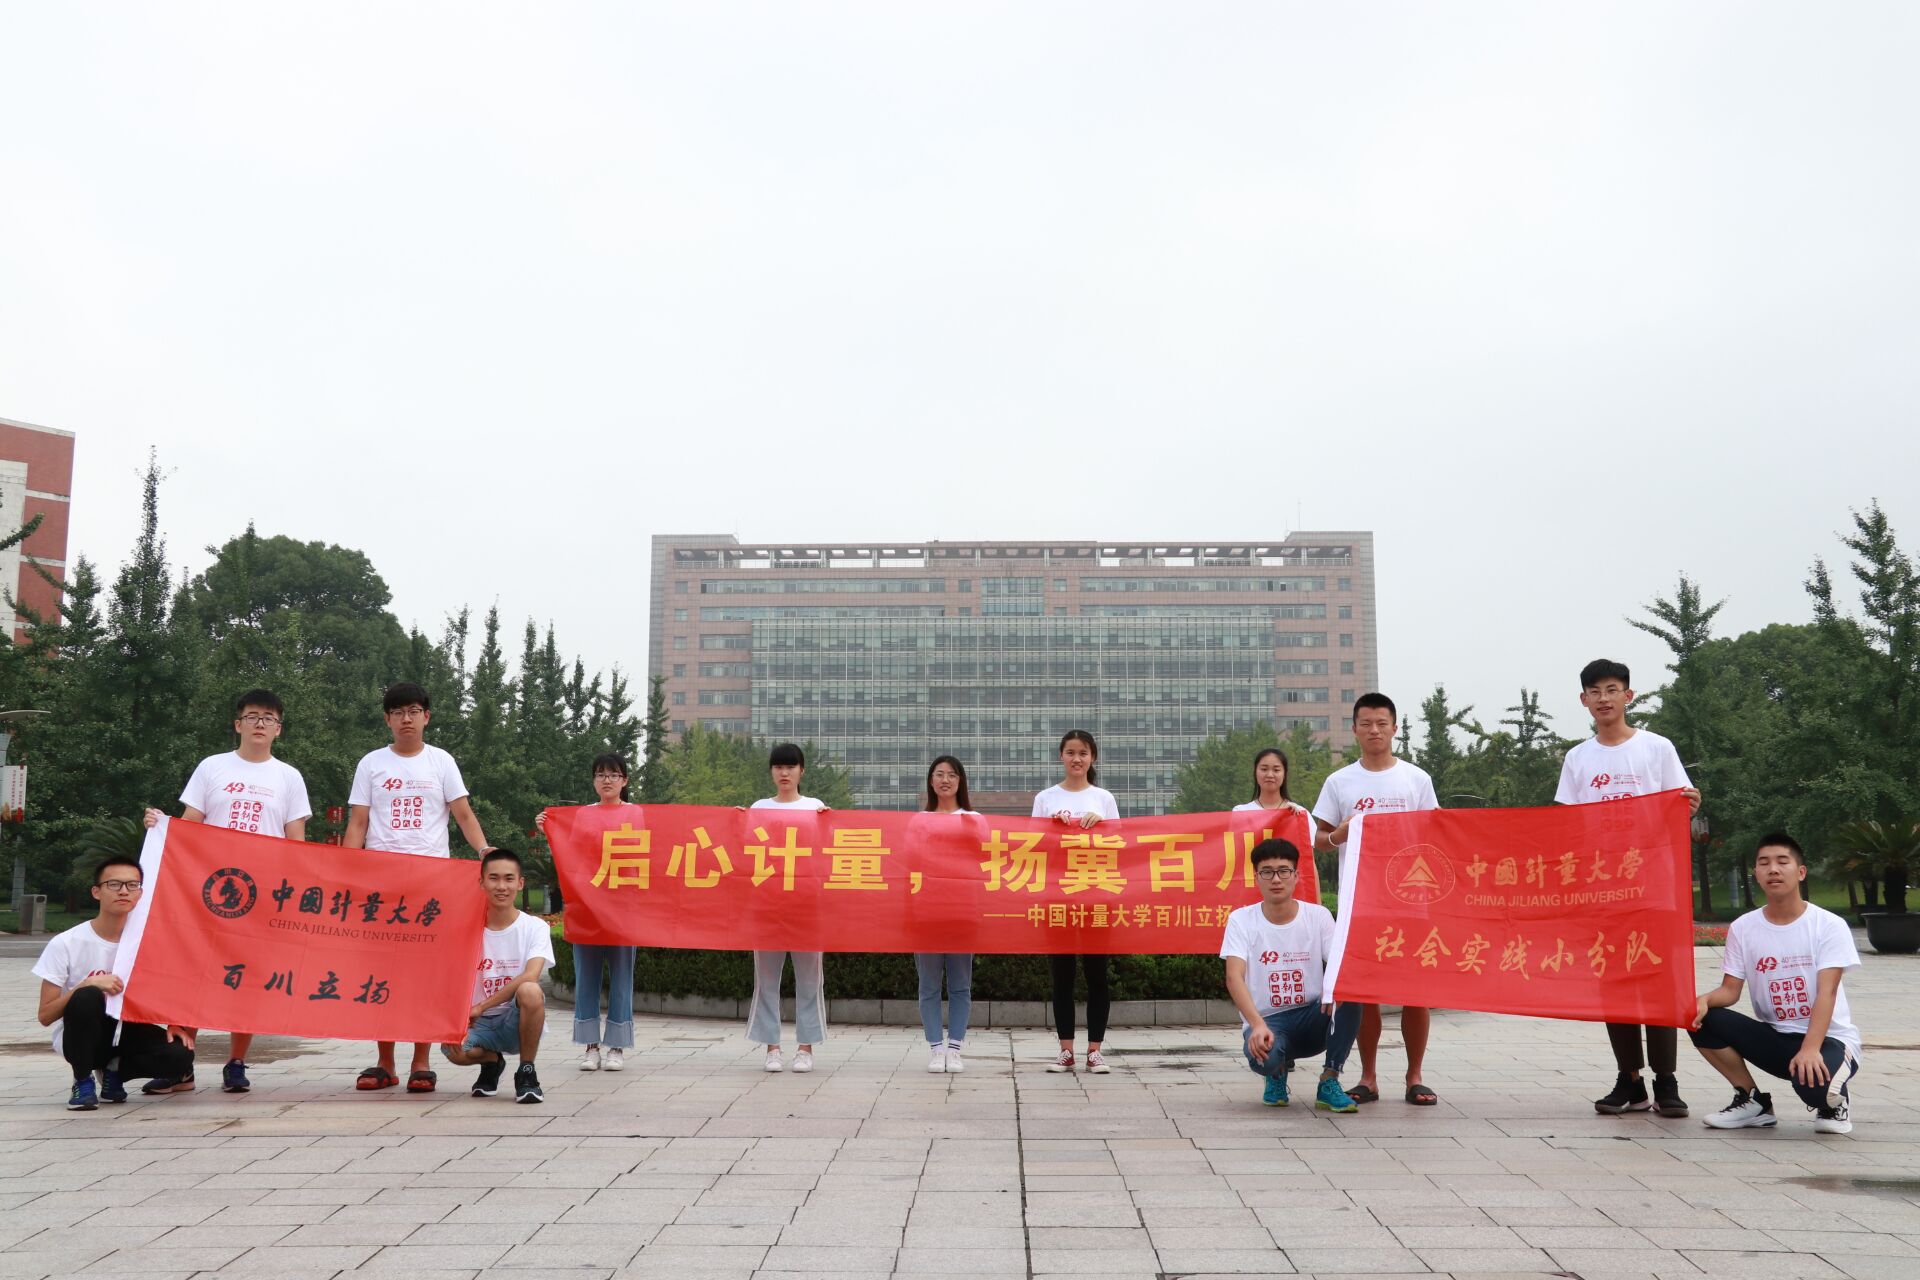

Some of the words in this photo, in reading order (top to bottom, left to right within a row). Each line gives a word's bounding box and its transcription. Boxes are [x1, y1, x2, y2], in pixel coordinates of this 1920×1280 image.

[1464, 894, 1506, 906] CHINA
[1508, 895, 1560, 907] JILIANG
[1564, 886, 1646, 905] UNIVERSITY
[983, 903, 1248, 929] ——中国计量大学百川立扬
[269, 918, 309, 933] CHINA
[311, 924, 360, 939] JILIANG
[362, 929, 438, 944] UNIVERSITY
[1375, 925, 1663, 980] 社会实践小分队
